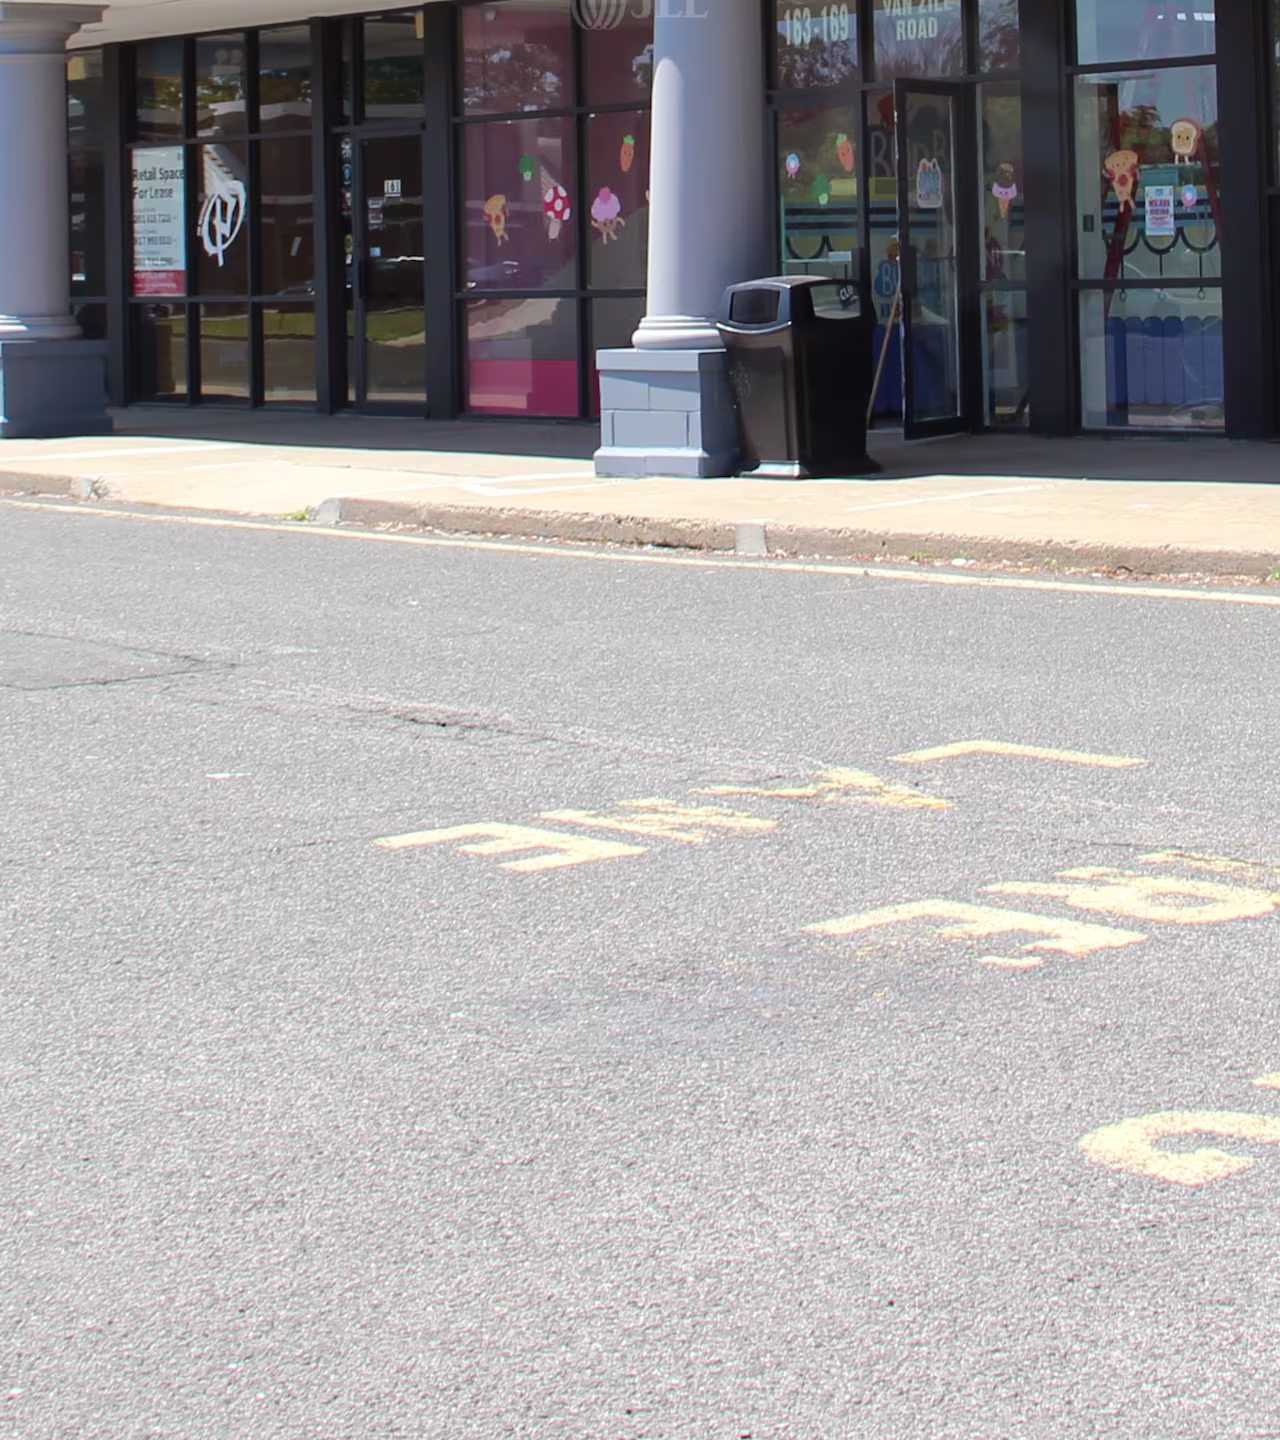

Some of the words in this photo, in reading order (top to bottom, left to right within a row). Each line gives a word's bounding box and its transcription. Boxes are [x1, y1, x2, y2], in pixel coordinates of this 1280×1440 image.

[784, 2, 850, 49] 163-169
[896, 17, 938, 41] ROAD
[133, 166, 157, 182] Retail
[159, 167, 185, 182] Space
[133, 187, 149, 200] For
[150, 186, 174, 199] Lease
